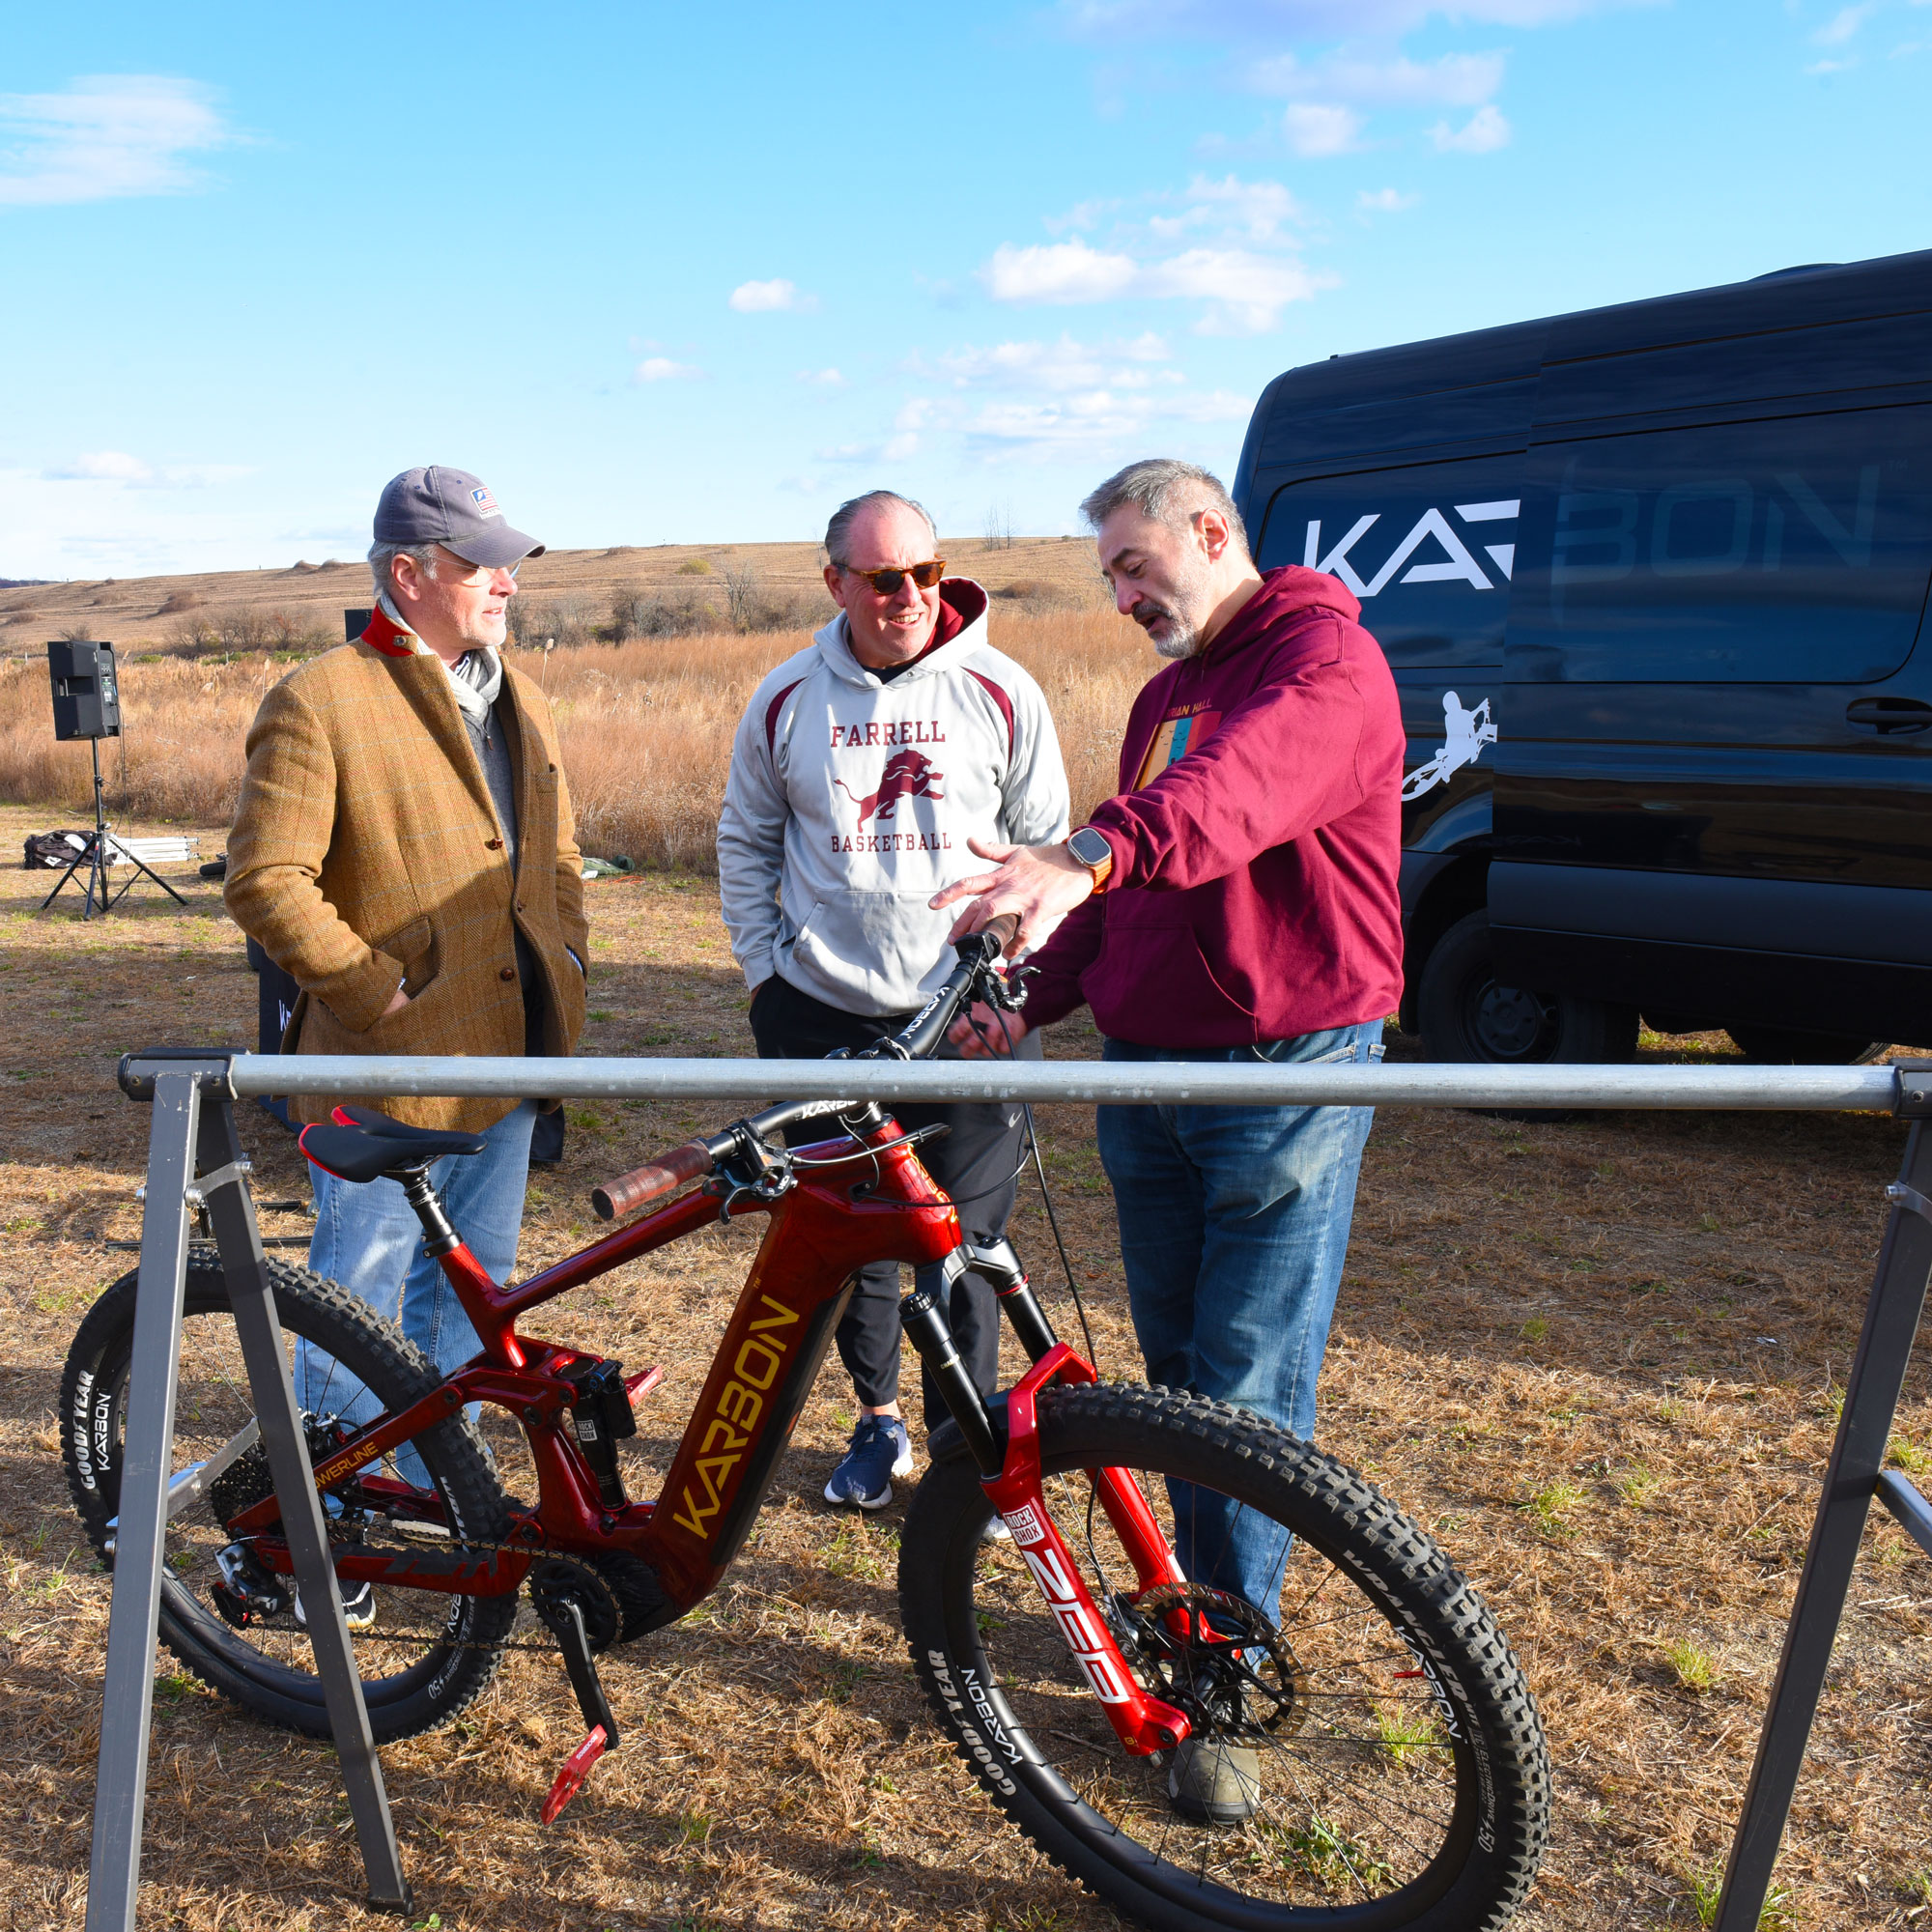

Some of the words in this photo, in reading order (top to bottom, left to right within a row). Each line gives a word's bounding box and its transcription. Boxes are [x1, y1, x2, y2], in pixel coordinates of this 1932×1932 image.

[831, 721, 946, 748] FARRELL
[831, 833, 952, 852] BASKETBALL
[72, 1370, 96, 1490] GOODYEAR
[94, 1392, 112, 1470] KARBON
[672, 1293, 800, 1540] KARBON
[1007, 1509, 1034, 1528] ROCK
[1014, 1525, 1040, 1543] SHOX
[1022, 1548, 1130, 1704] ZEB
[1344, 1549, 1468, 1702] WRANGLER
[927, 1650, 1016, 1796] GOODYEAR
[960, 1668, 1024, 1765] KARBON
